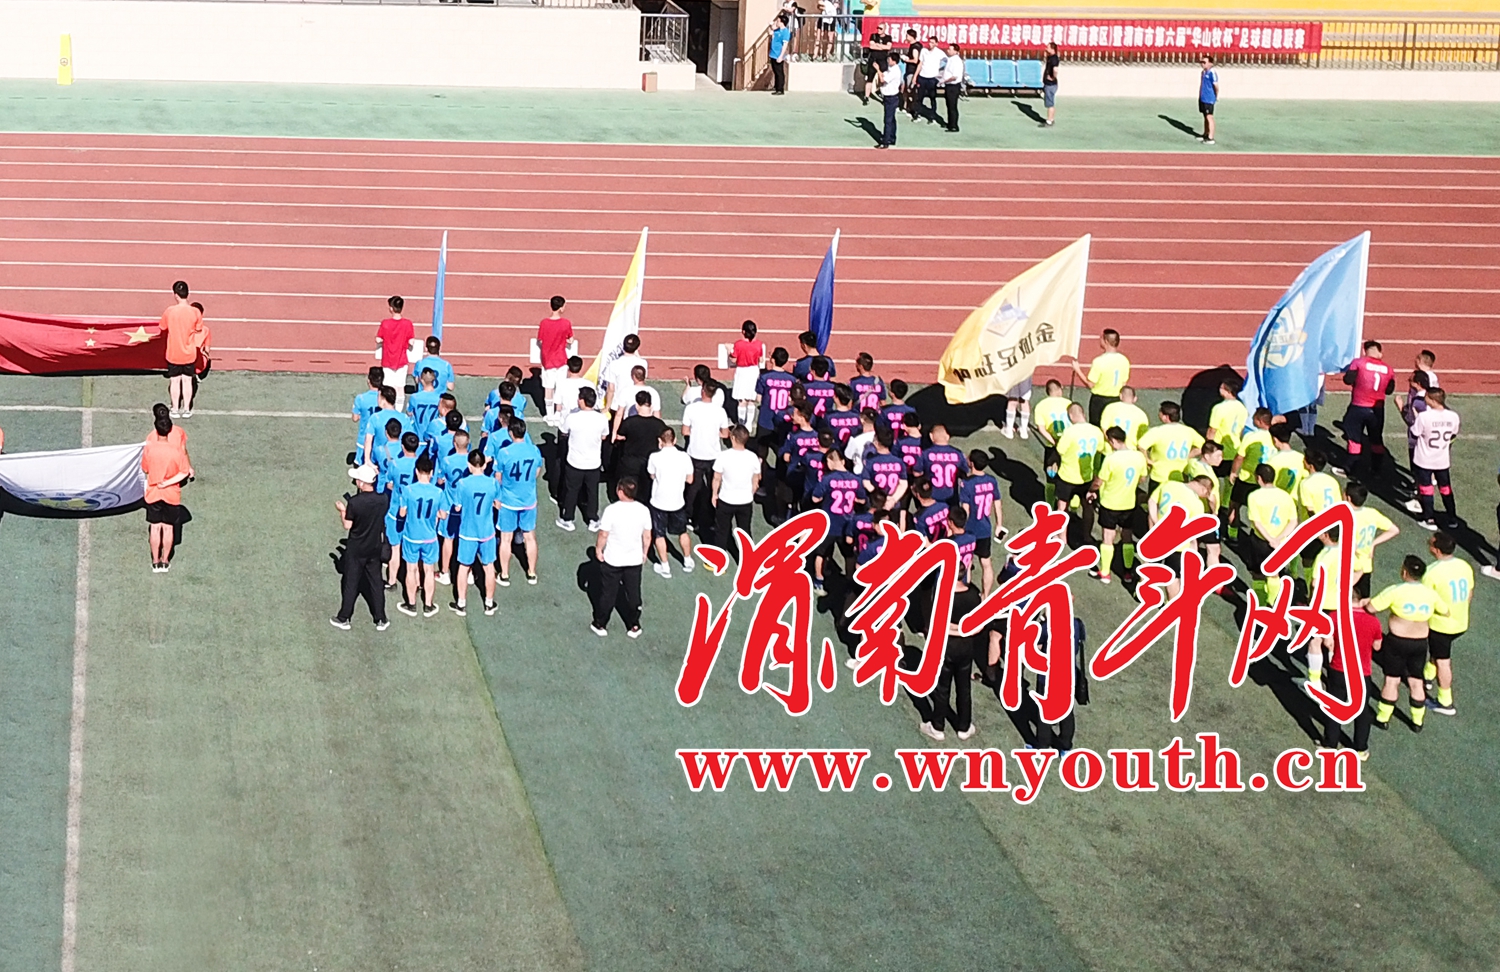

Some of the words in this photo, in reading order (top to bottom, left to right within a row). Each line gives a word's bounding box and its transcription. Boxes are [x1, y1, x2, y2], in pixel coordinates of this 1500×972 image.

[1374, 372, 1381, 391] 1
[769, 388, 788, 410] 10
[1167, 441, 1188, 460] 66
[509, 459, 534, 481] 47
[931, 463, 958, 487] 30
[1125, 467, 1135, 486] 9
[416, 497, 434, 519] 11
[473, 492, 486, 515] 7
[830, 490, 855, 514] 23
[1324, 488, 1334, 507] 5
[1449, 578, 1467, 603] 18
